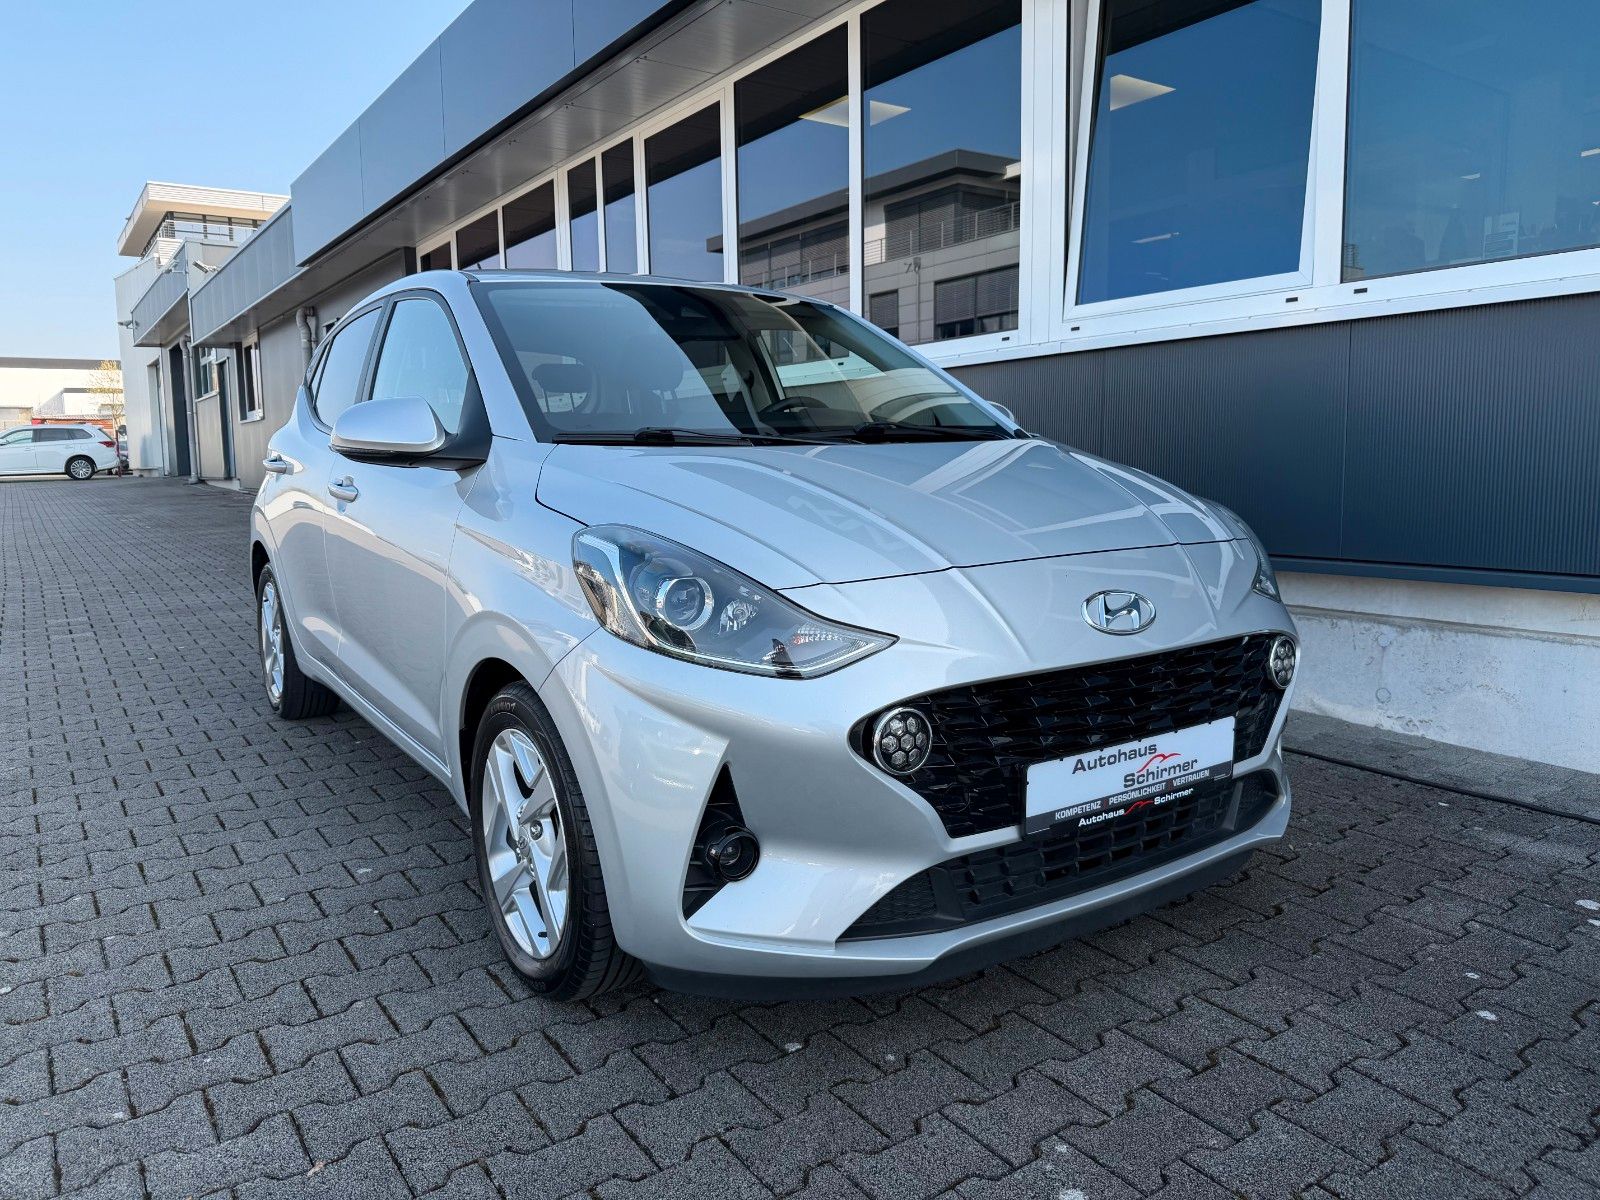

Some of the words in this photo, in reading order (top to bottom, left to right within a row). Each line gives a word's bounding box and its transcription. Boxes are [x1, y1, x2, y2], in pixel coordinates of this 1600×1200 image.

[1072, 743, 1158, 775] Autohaus
[1123, 758, 1198, 789] Schirmer
[1055, 801, 1102, 820] KOMPETENZ
[1109, 782, 1167, 806] PERSÖNLICHKEIT
[1172, 769, 1210, 787] VERTRAUEN
[1078, 808, 1125, 827] Autohaus
[1153, 787, 1194, 805] Schirmer
